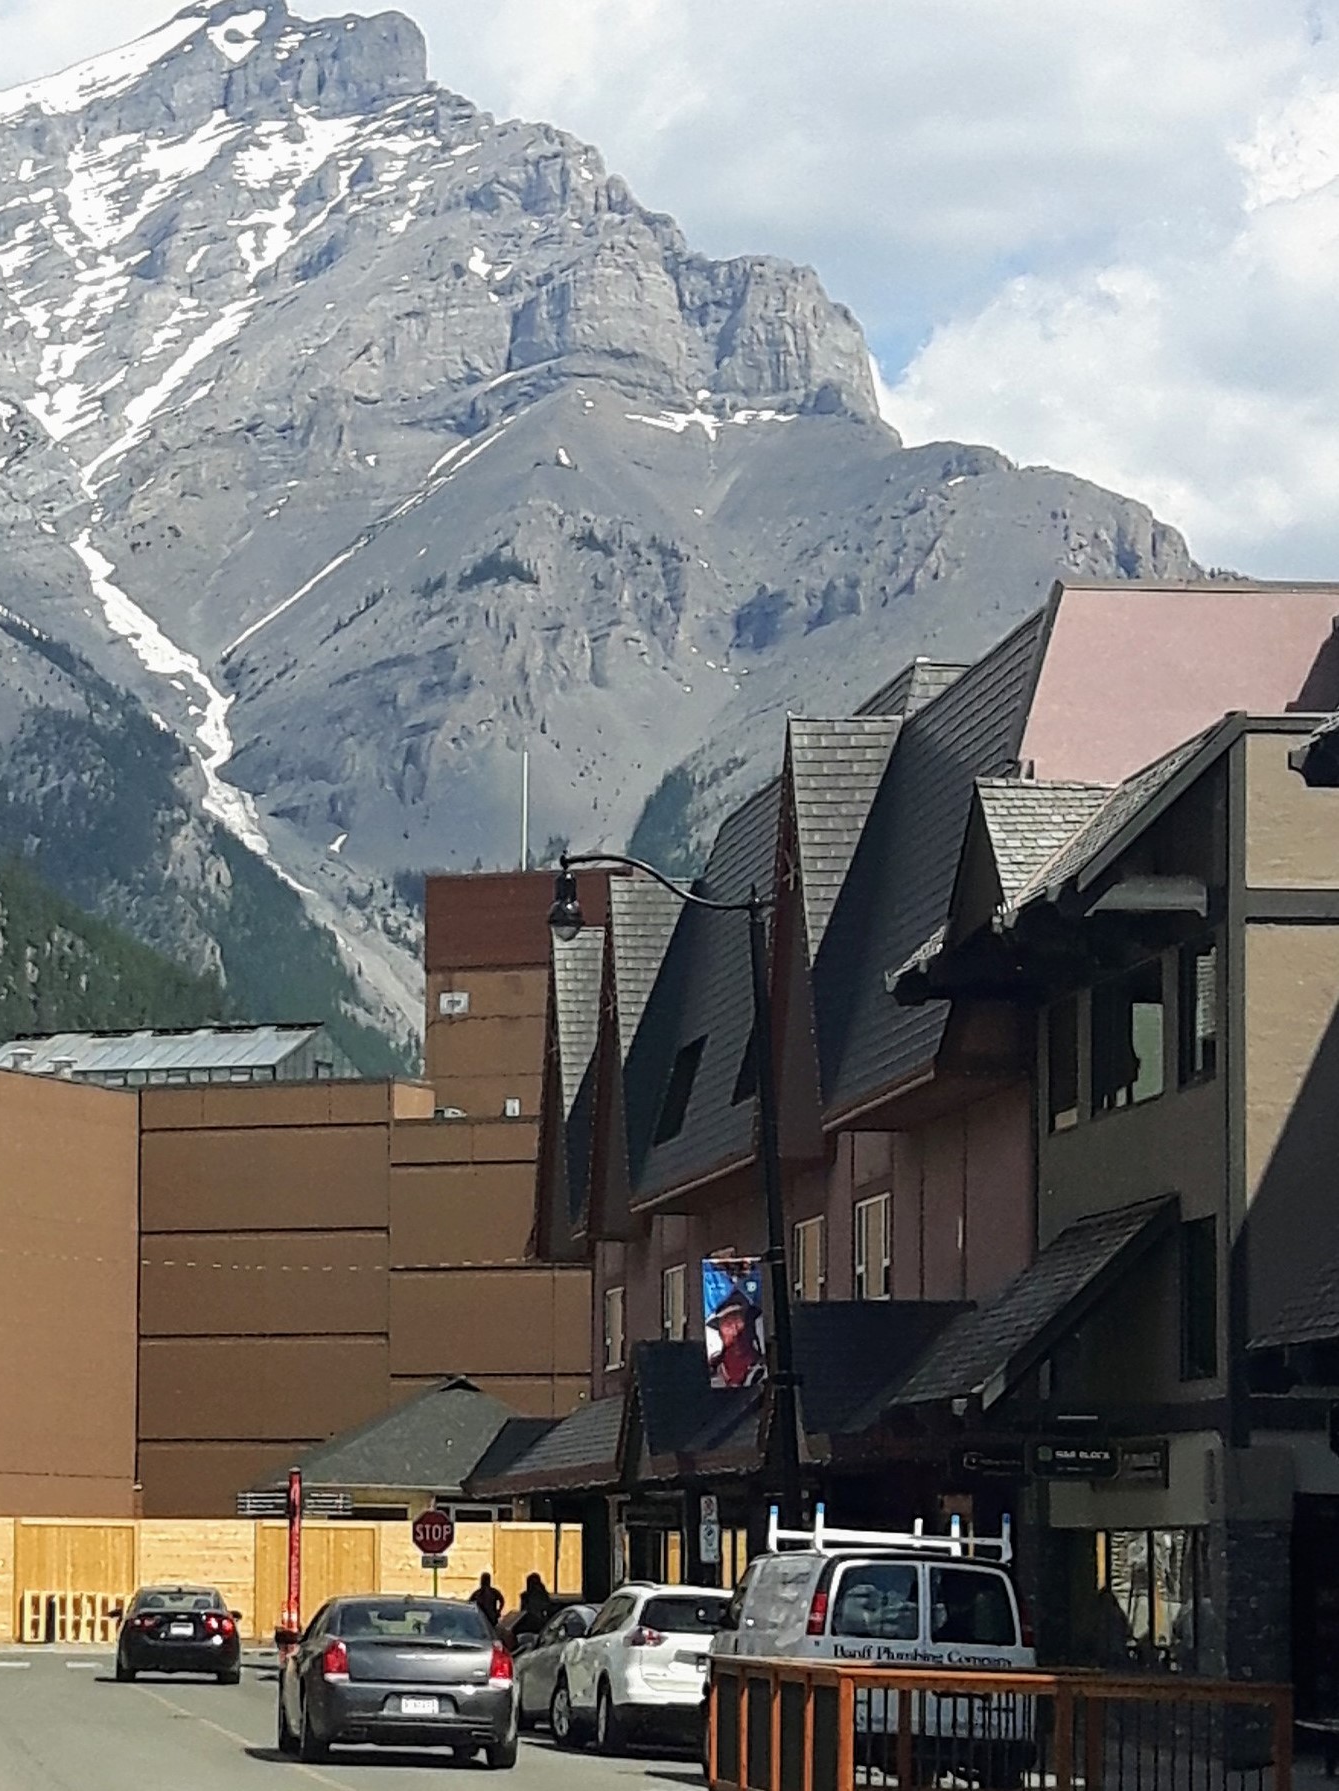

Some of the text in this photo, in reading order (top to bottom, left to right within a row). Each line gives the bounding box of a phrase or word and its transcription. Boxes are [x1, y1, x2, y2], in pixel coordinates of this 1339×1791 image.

[415, 1523, 451, 1541] STOP
[833, 1643, 873, 1660] Banff
[876, 1646, 944, 1665] Plumbing
